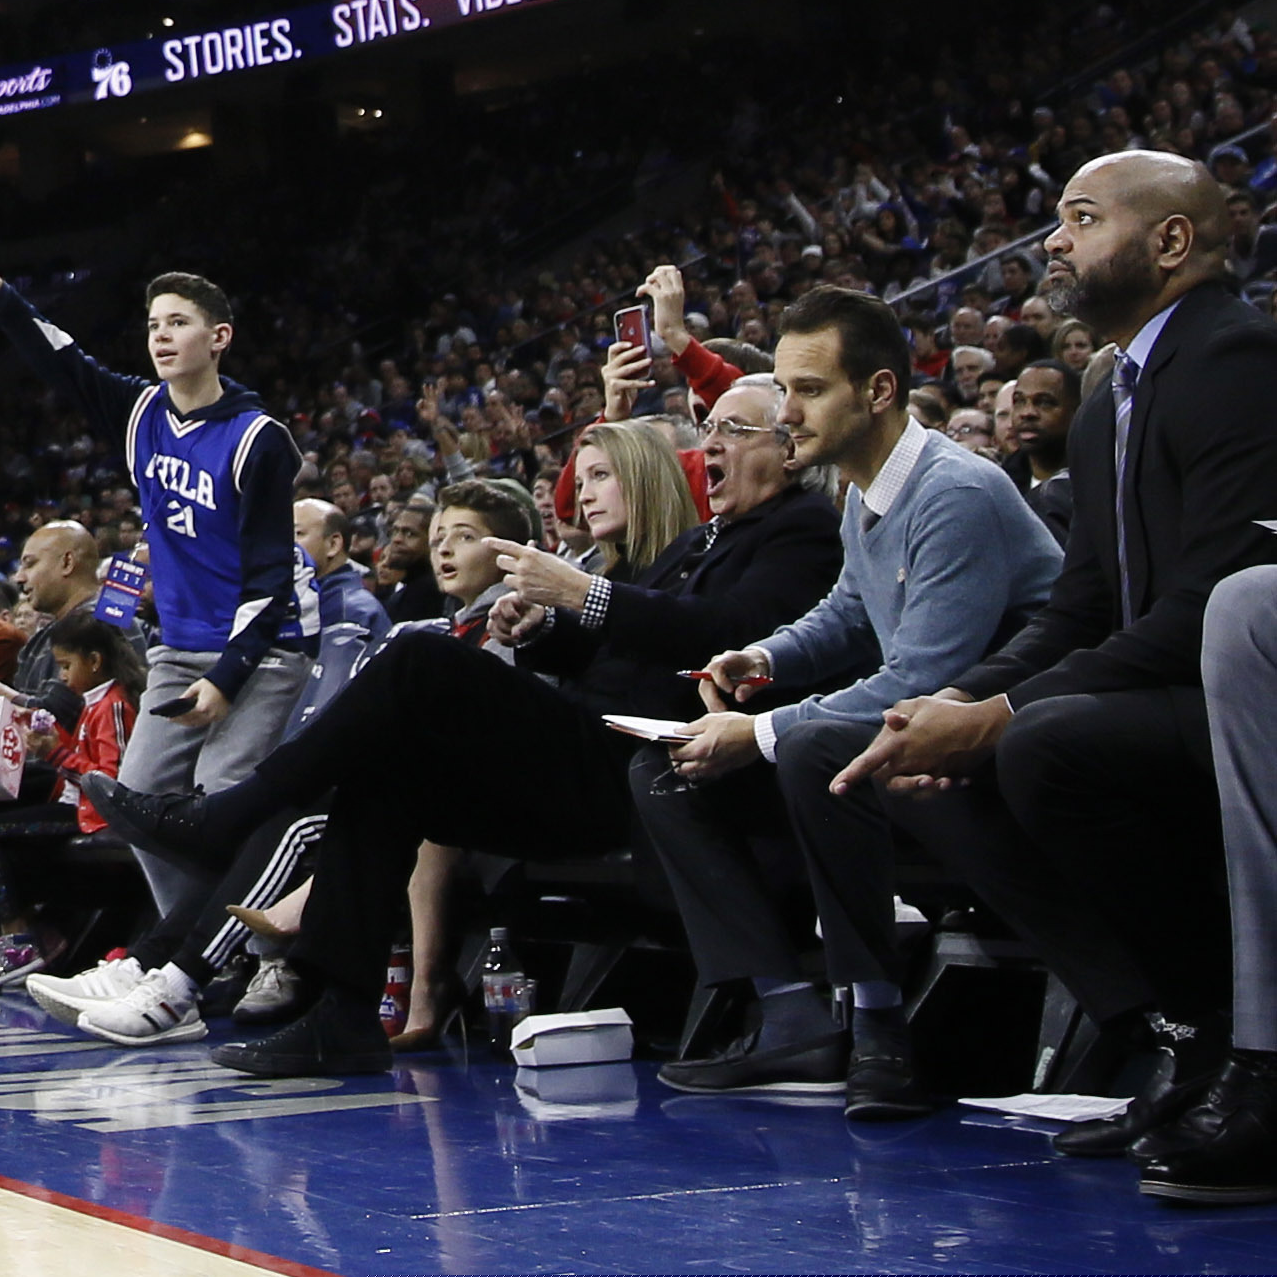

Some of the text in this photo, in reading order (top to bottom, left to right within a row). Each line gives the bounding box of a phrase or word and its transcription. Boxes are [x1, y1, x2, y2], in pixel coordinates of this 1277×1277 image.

[92, 61, 132, 101] 76
[163, 19, 302, 83] STORIES.
[167, 500, 197, 538] 21
